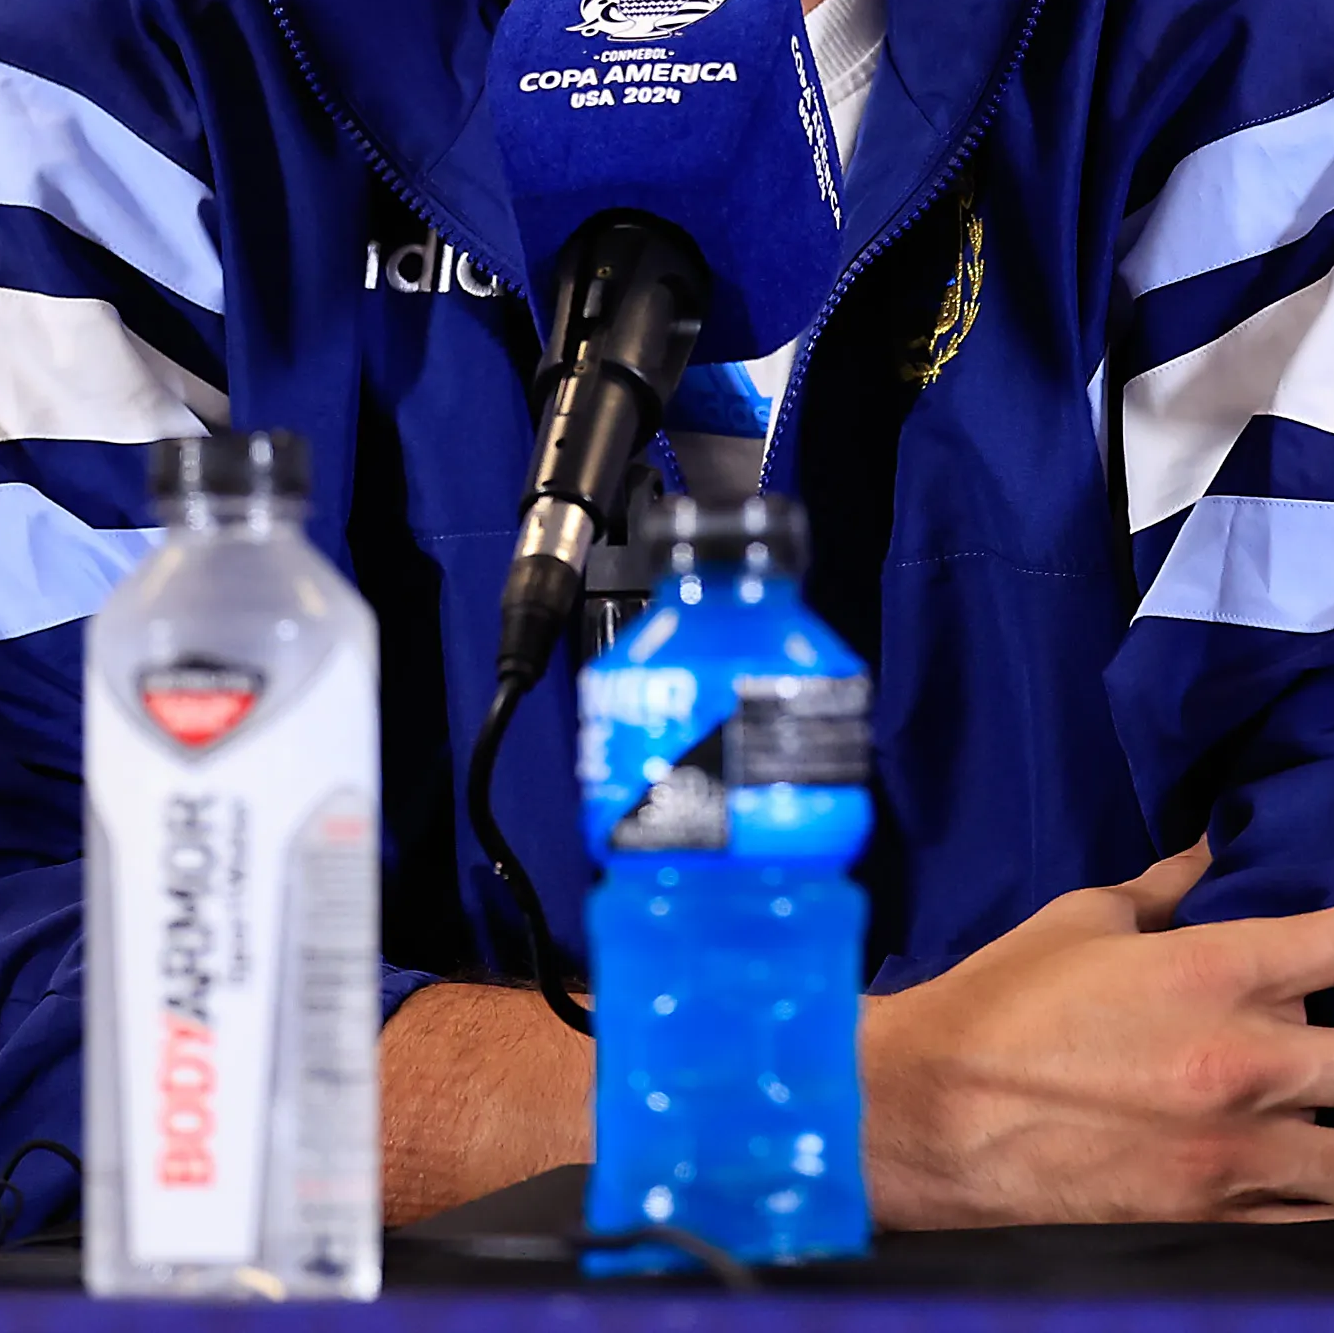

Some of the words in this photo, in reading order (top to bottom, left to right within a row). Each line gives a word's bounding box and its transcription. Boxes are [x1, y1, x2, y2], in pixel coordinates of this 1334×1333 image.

[518, 67, 599, 92] COPA
[602, 62, 739, 85] AMERICA
[569, 88, 616, 109] USA
[621, 86, 682, 105] 2024
[790, 34, 813, 110] COPA
[155, 793, 219, 1192] BODYARMOR
